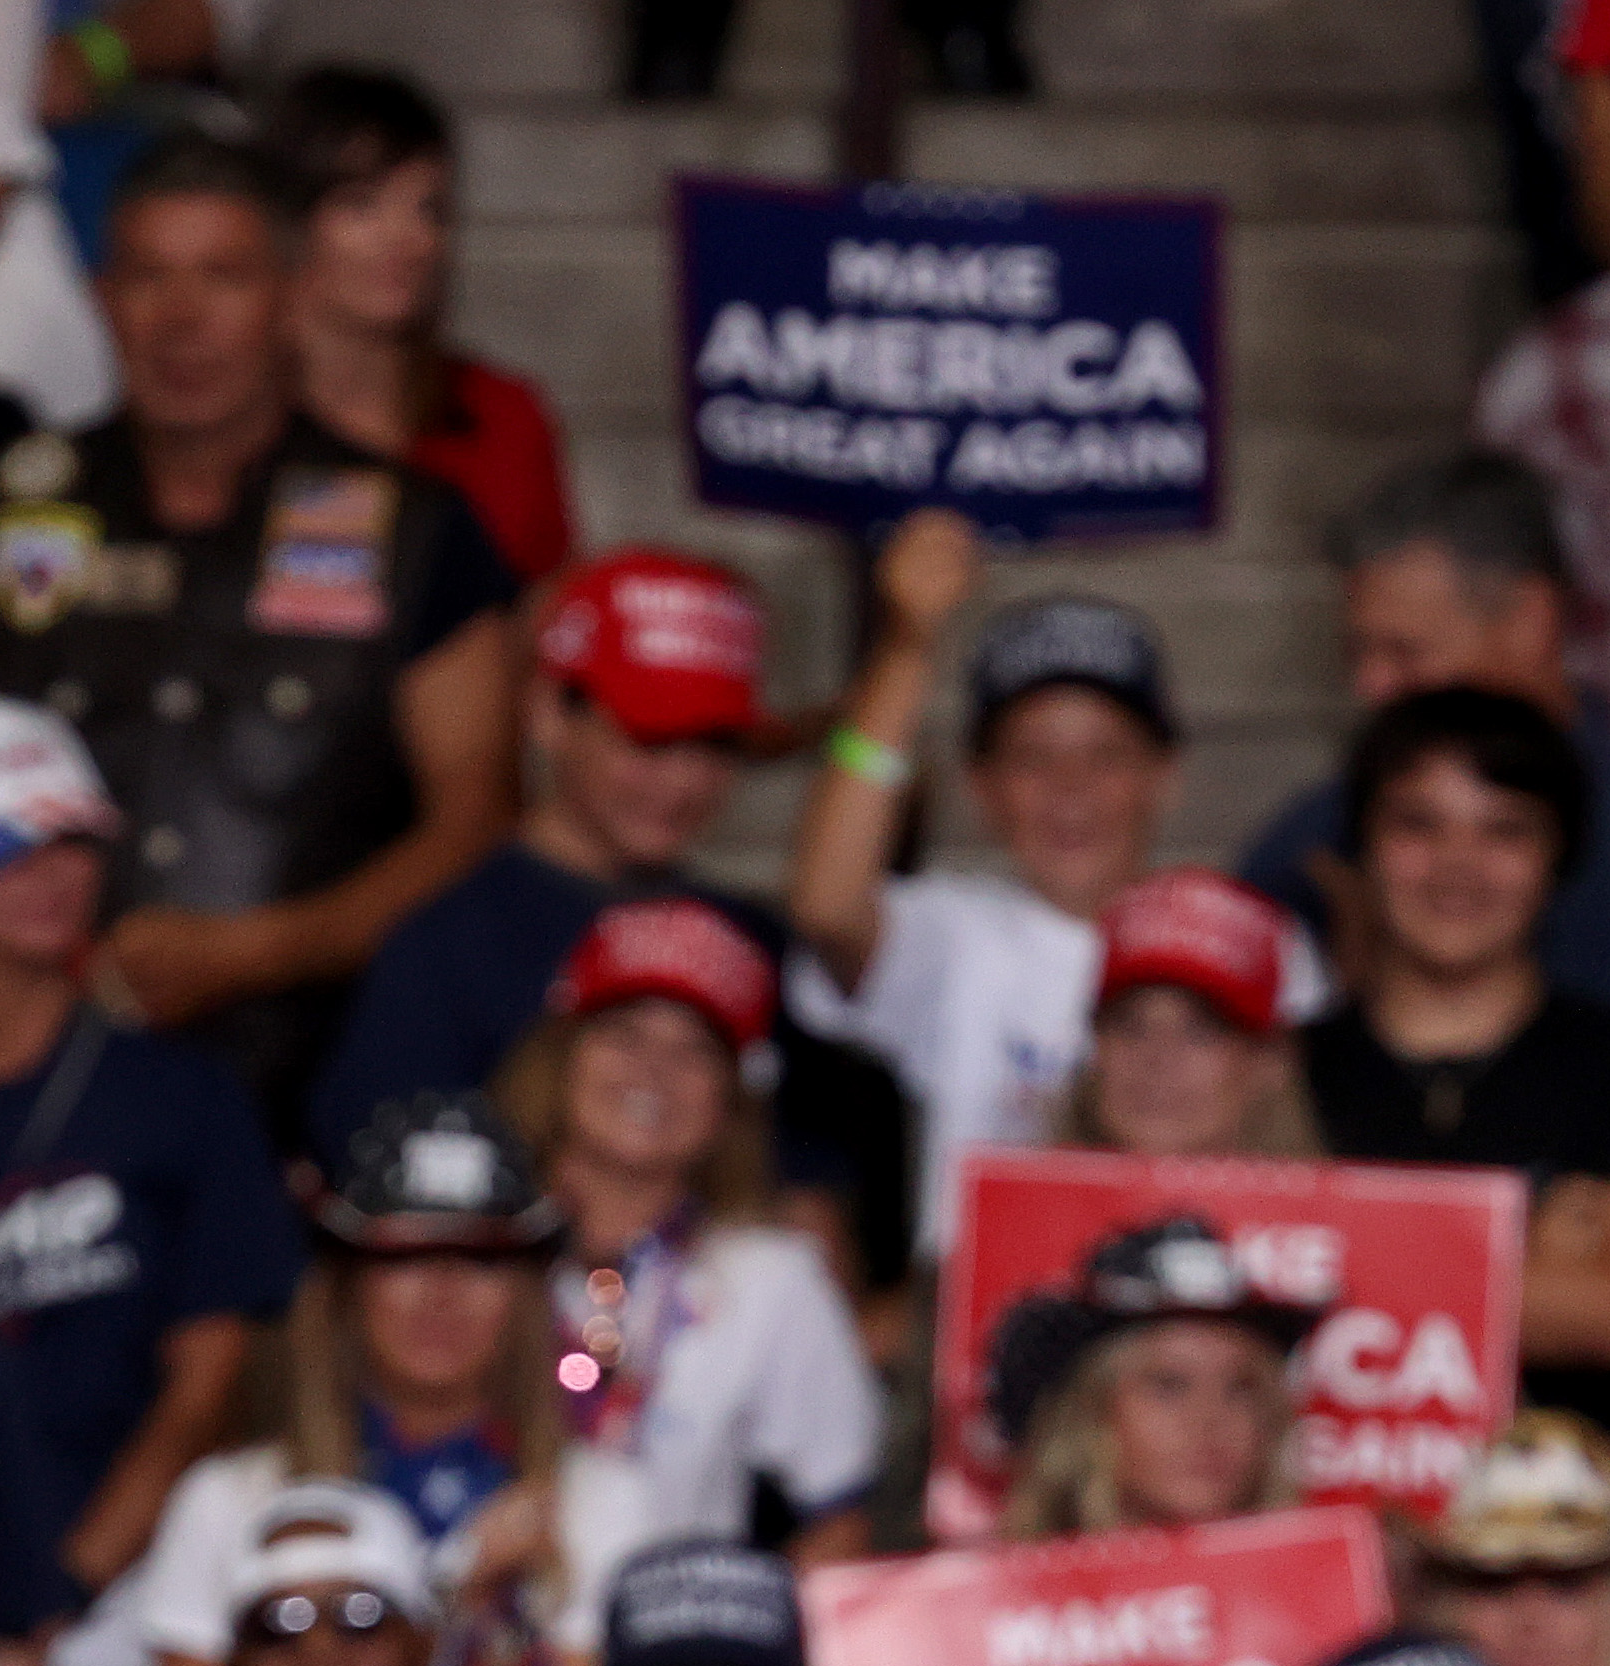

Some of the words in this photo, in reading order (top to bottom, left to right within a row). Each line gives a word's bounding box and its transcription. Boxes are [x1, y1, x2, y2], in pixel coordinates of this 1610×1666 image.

[825, 238, 1062, 319] MAKE
[695, 299, 1204, 416] AMERICA
[696, 395, 951, 491] GREAT
[946, 415, 1209, 493] AGAIN
